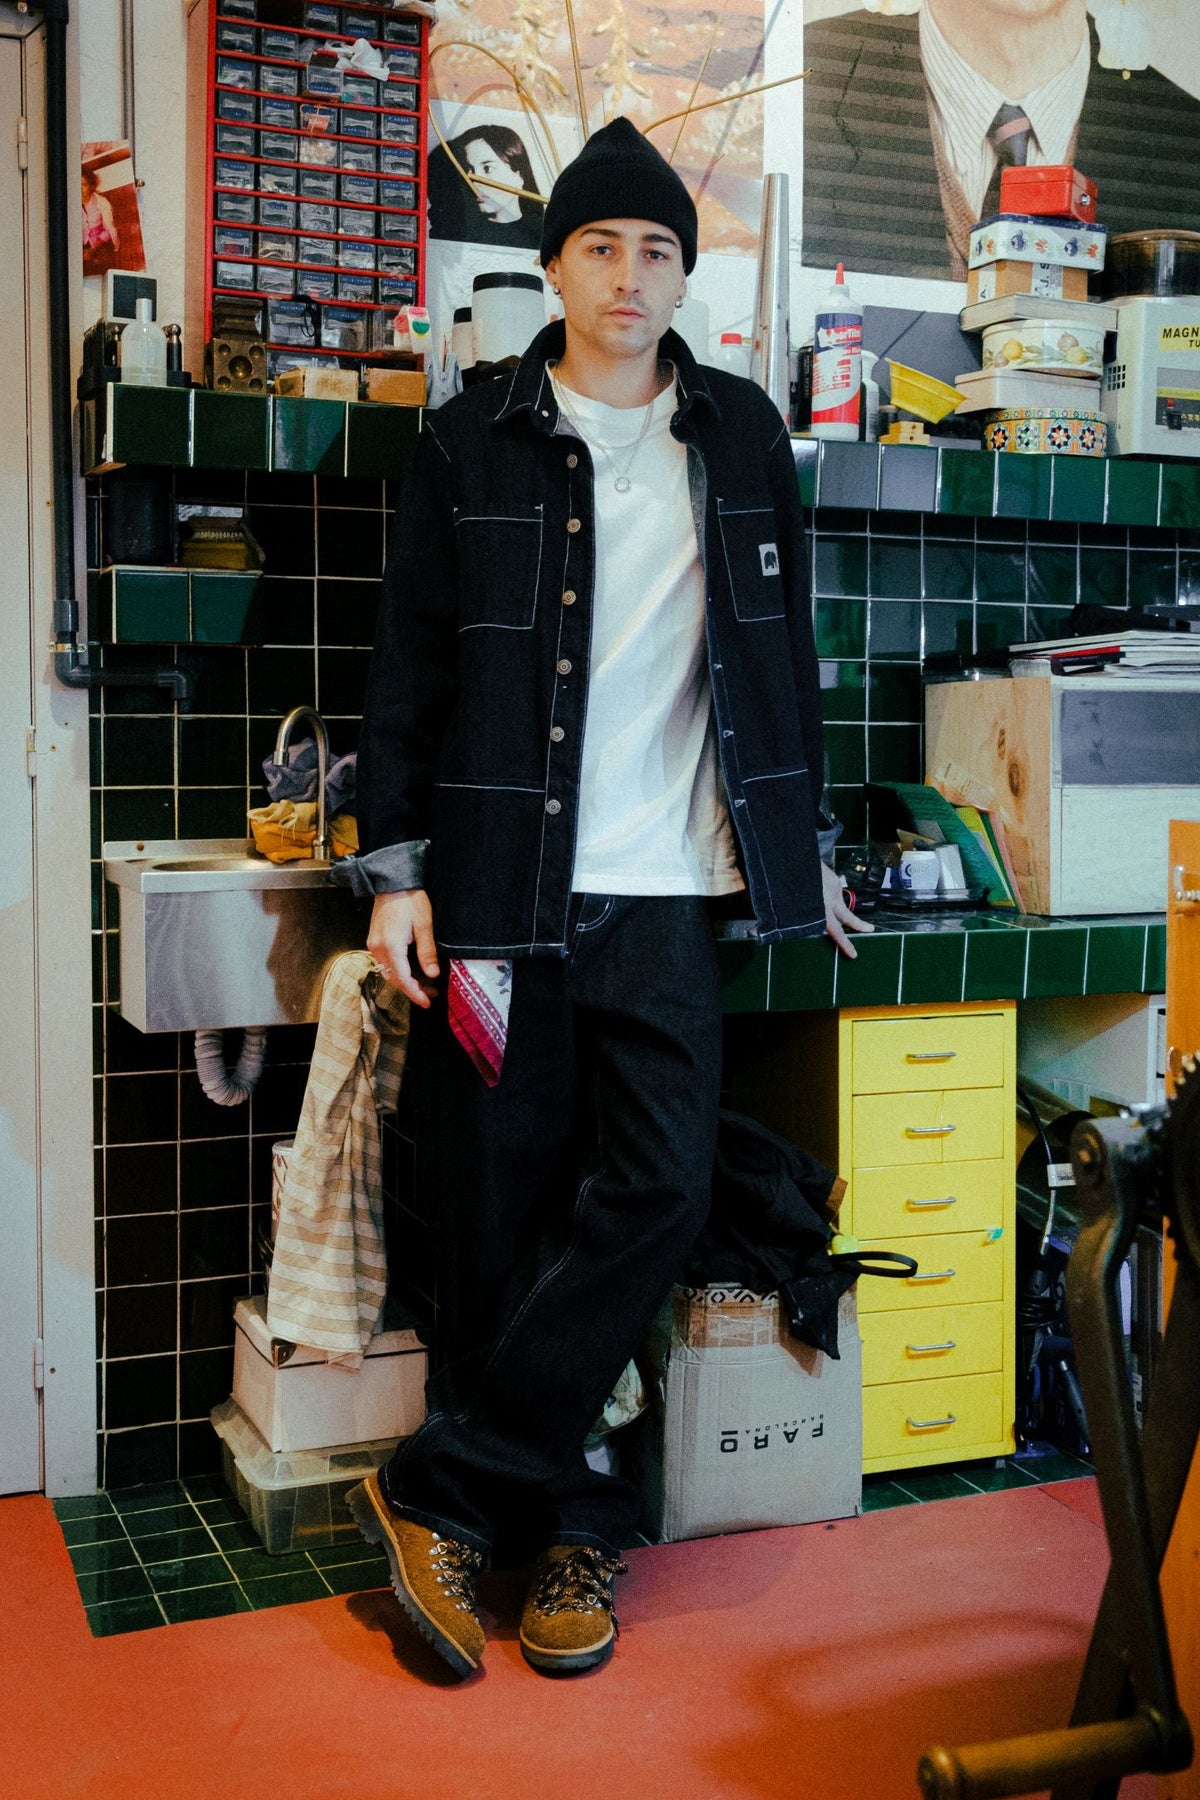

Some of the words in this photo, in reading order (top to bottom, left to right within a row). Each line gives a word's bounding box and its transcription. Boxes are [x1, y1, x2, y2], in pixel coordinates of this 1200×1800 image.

[1162, 327, 1200, 339] MAGN
[745, 1414, 824, 1434] BARCELONA
[721, 1423, 824, 1453] FARO
